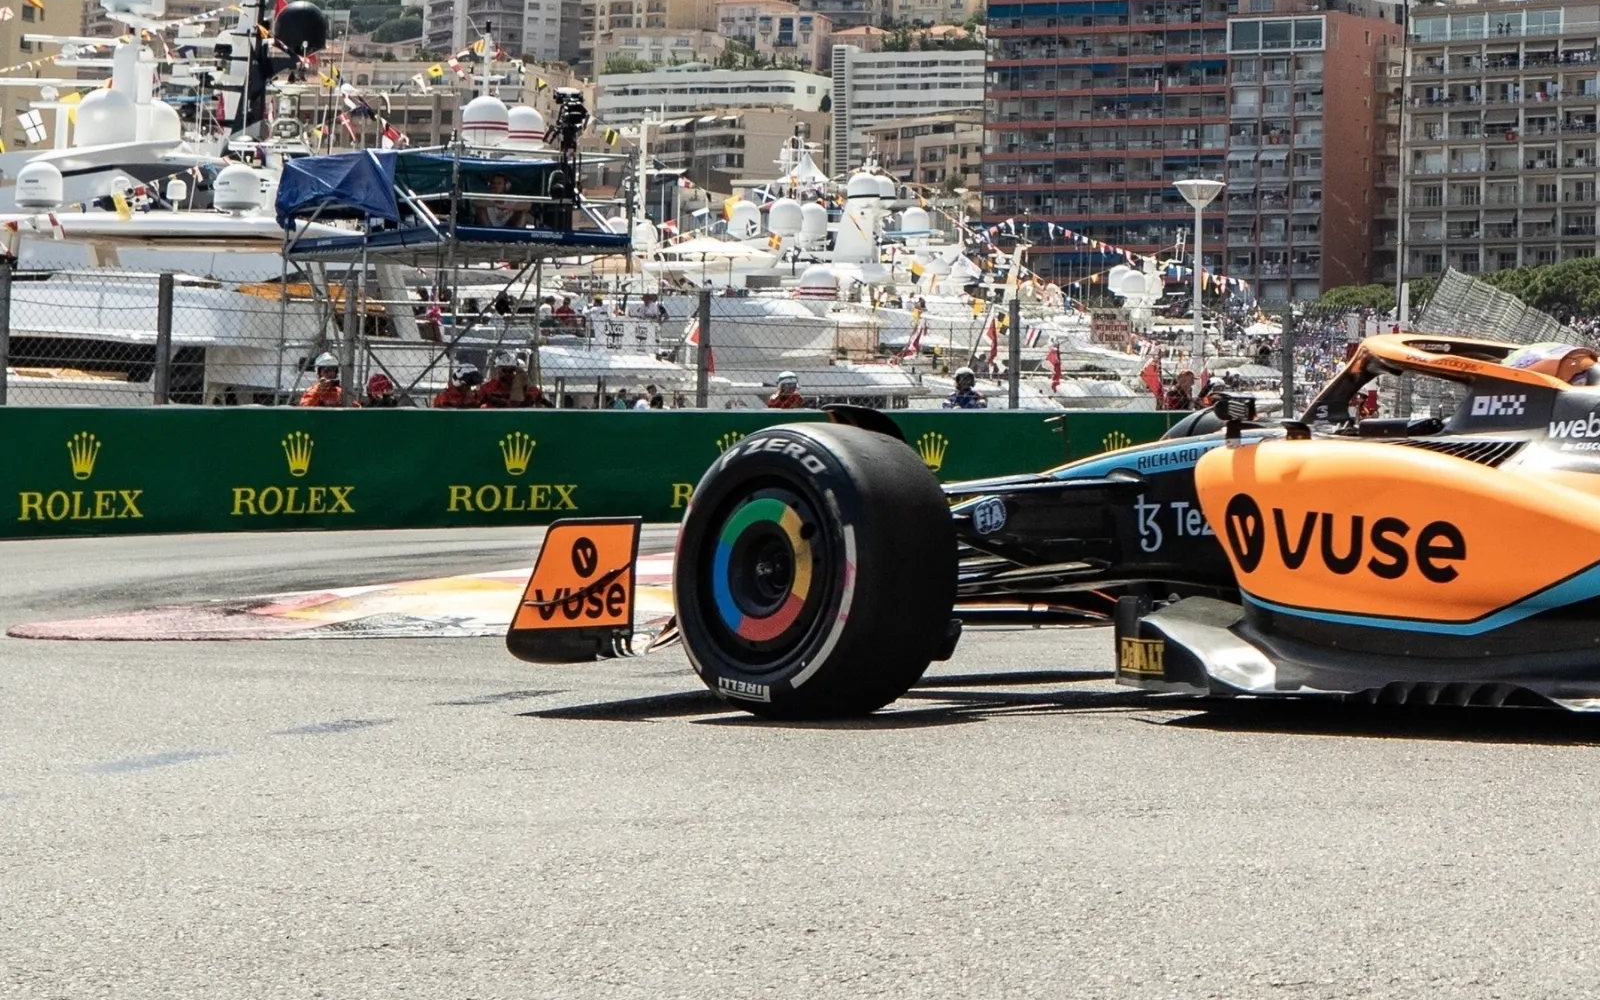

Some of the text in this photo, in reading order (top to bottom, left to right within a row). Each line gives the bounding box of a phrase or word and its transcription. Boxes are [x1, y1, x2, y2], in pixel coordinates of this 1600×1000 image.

[1471, 395, 1526, 416] OKX
[743, 438, 828, 474] ZERO
[1137, 447, 1198, 469] RICHARD
[18, 490, 144, 521] ROLEX
[231, 486, 356, 515] ROLEX
[447, 484, 579, 511] ROLEX
[1171, 501, 1216, 536] Tez
[718, 676, 771, 702] PIRELLI
